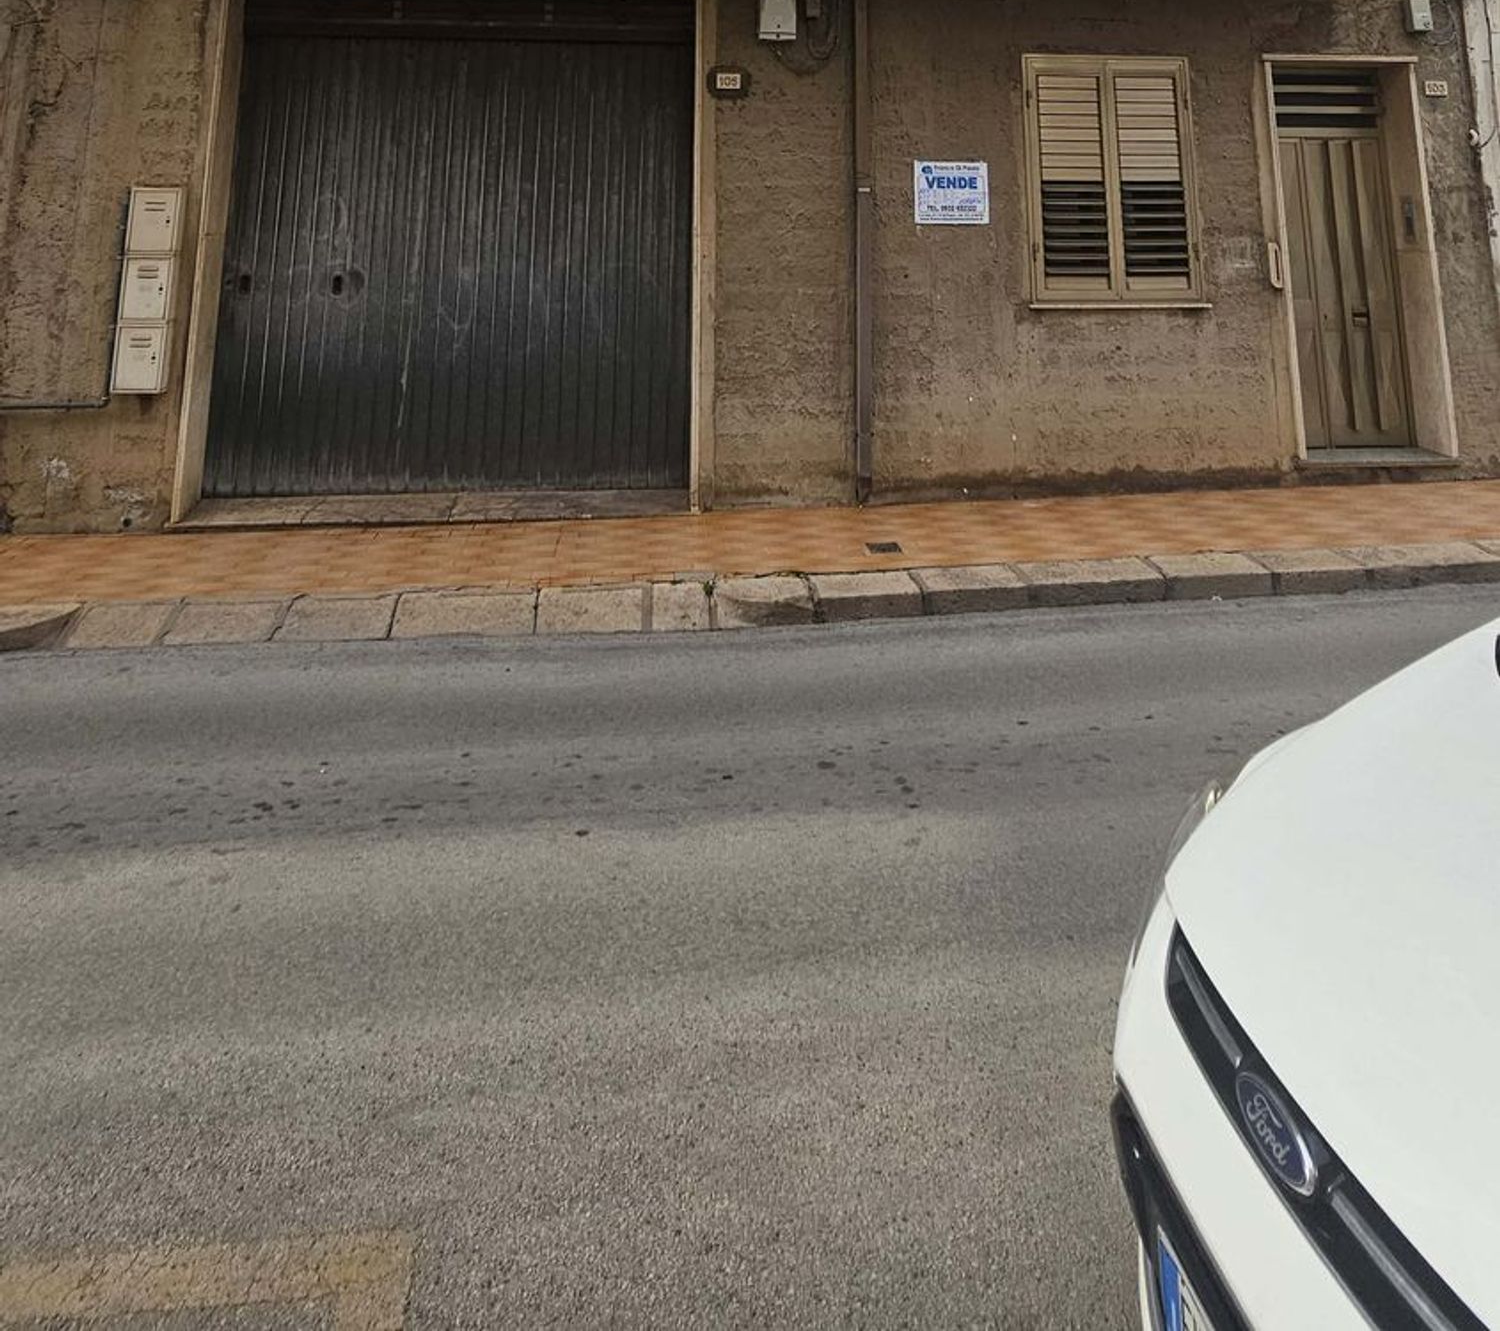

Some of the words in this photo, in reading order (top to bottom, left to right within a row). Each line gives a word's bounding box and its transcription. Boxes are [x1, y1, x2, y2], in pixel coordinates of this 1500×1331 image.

[719, 75, 738, 87] 105
[925, 176, 978, 189] VENDE
[1245, 1094, 1291, 1166] Ford
